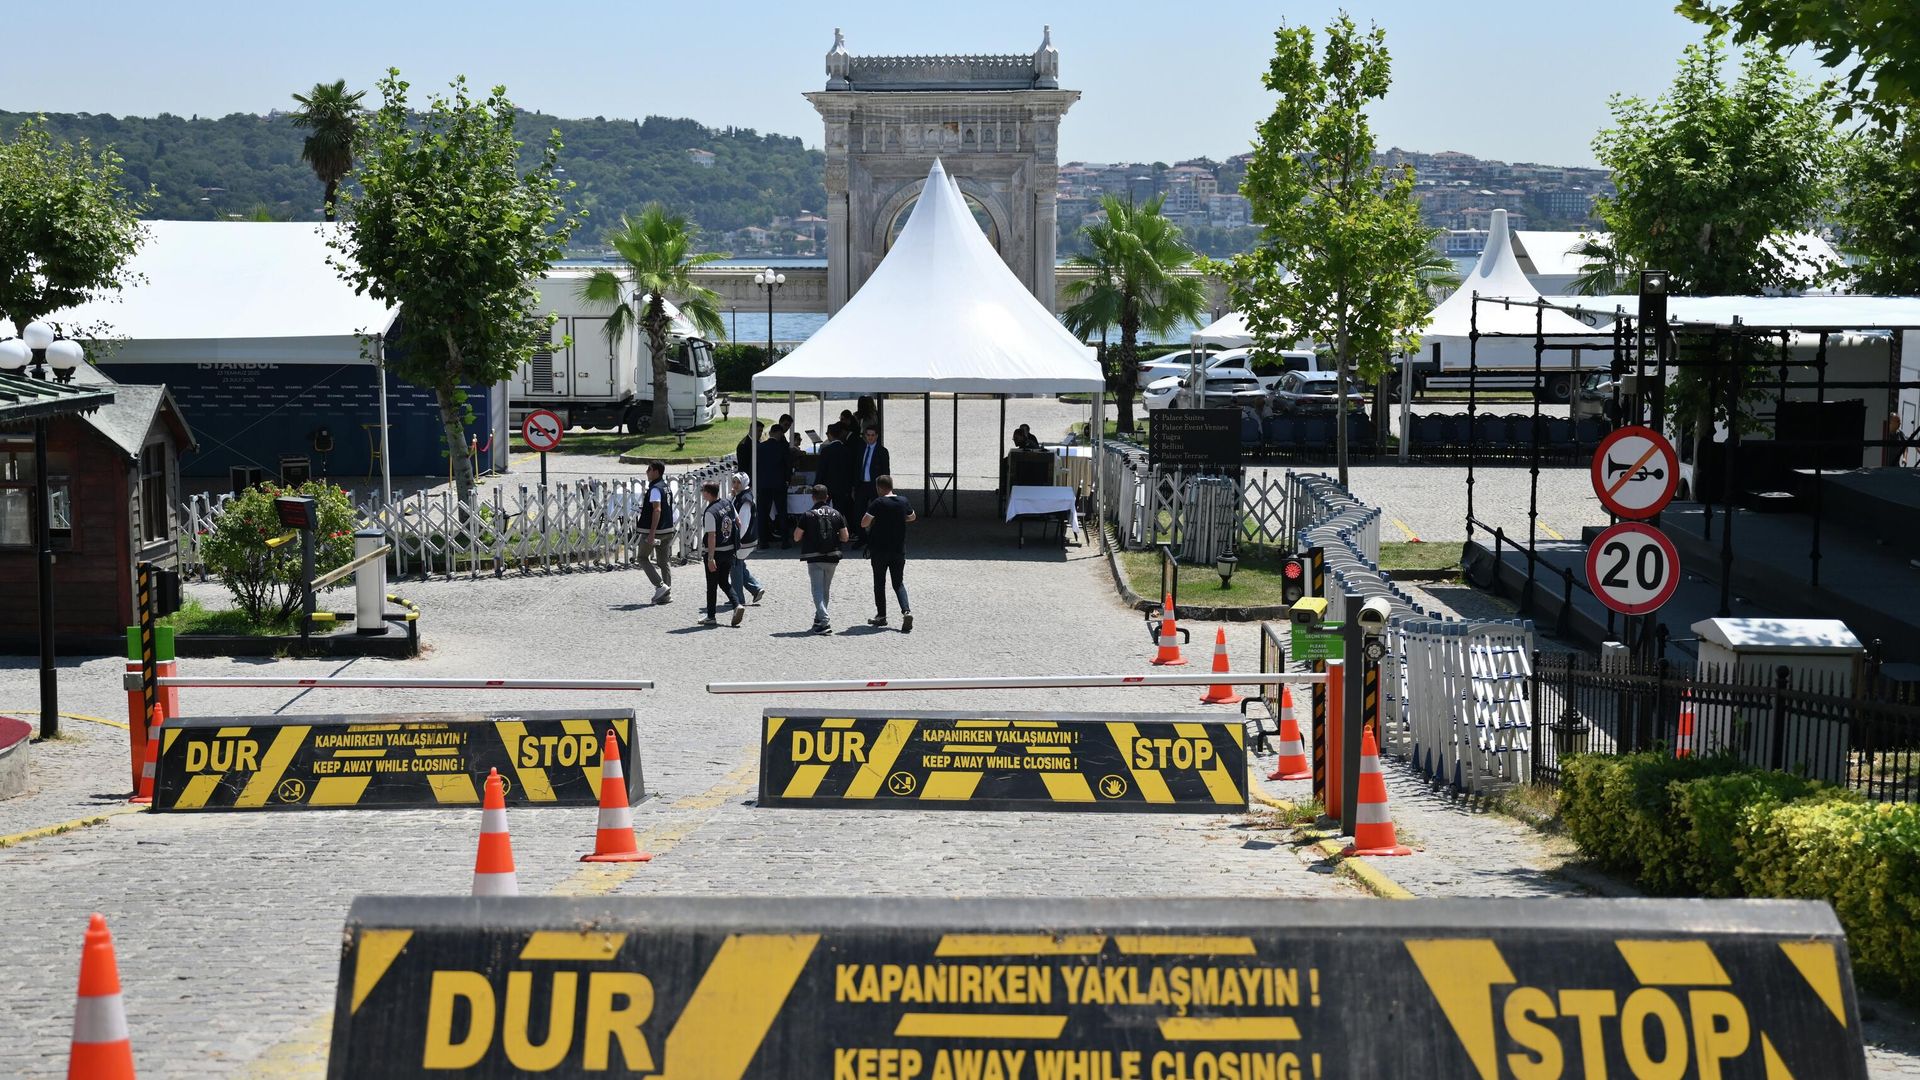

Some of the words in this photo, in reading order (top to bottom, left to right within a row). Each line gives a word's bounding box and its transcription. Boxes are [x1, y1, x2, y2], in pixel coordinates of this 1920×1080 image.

[1601, 542, 1664, 590] 20
[315, 733, 383, 747] KAPANIRKEN
[386, 732, 460, 748] YAKLAŞMAYIN
[521, 736, 598, 767] STOP
[791, 731, 866, 763] DUR
[923, 729, 993, 743] KAPANIRKEN
[996, 730, 1071, 747] YAKLAŞMAYIN
[1135, 738, 1213, 770] STOP
[185, 740, 260, 772] DUR
[313, 760, 341, 774] KEEP
[343, 760, 373, 773] AWAY
[375, 759, 408, 773] WHILE
[411, 758, 458, 772] CLOSING
[923, 755, 951, 768] KEEP
[953, 756, 984, 768] AWAY
[986, 756, 1021, 769] WHILE
[1023, 756, 1071, 770] CLOSING
[836, 964, 1051, 1003] KAPANIRKEN
[1061, 965, 1299, 1016] YAKLAŞMAYIN
[1309, 968, 1320, 1007] !
[423, 970, 655, 1071] DUR
[1503, 986, 1750, 1080] STOP
[834, 1048, 922, 1080] KEEP
[932, 1049, 1025, 1080] AWAY
[1035, 1050, 1140, 1080] WHILE
[1151, 1051, 1300, 1080] CLOSING
